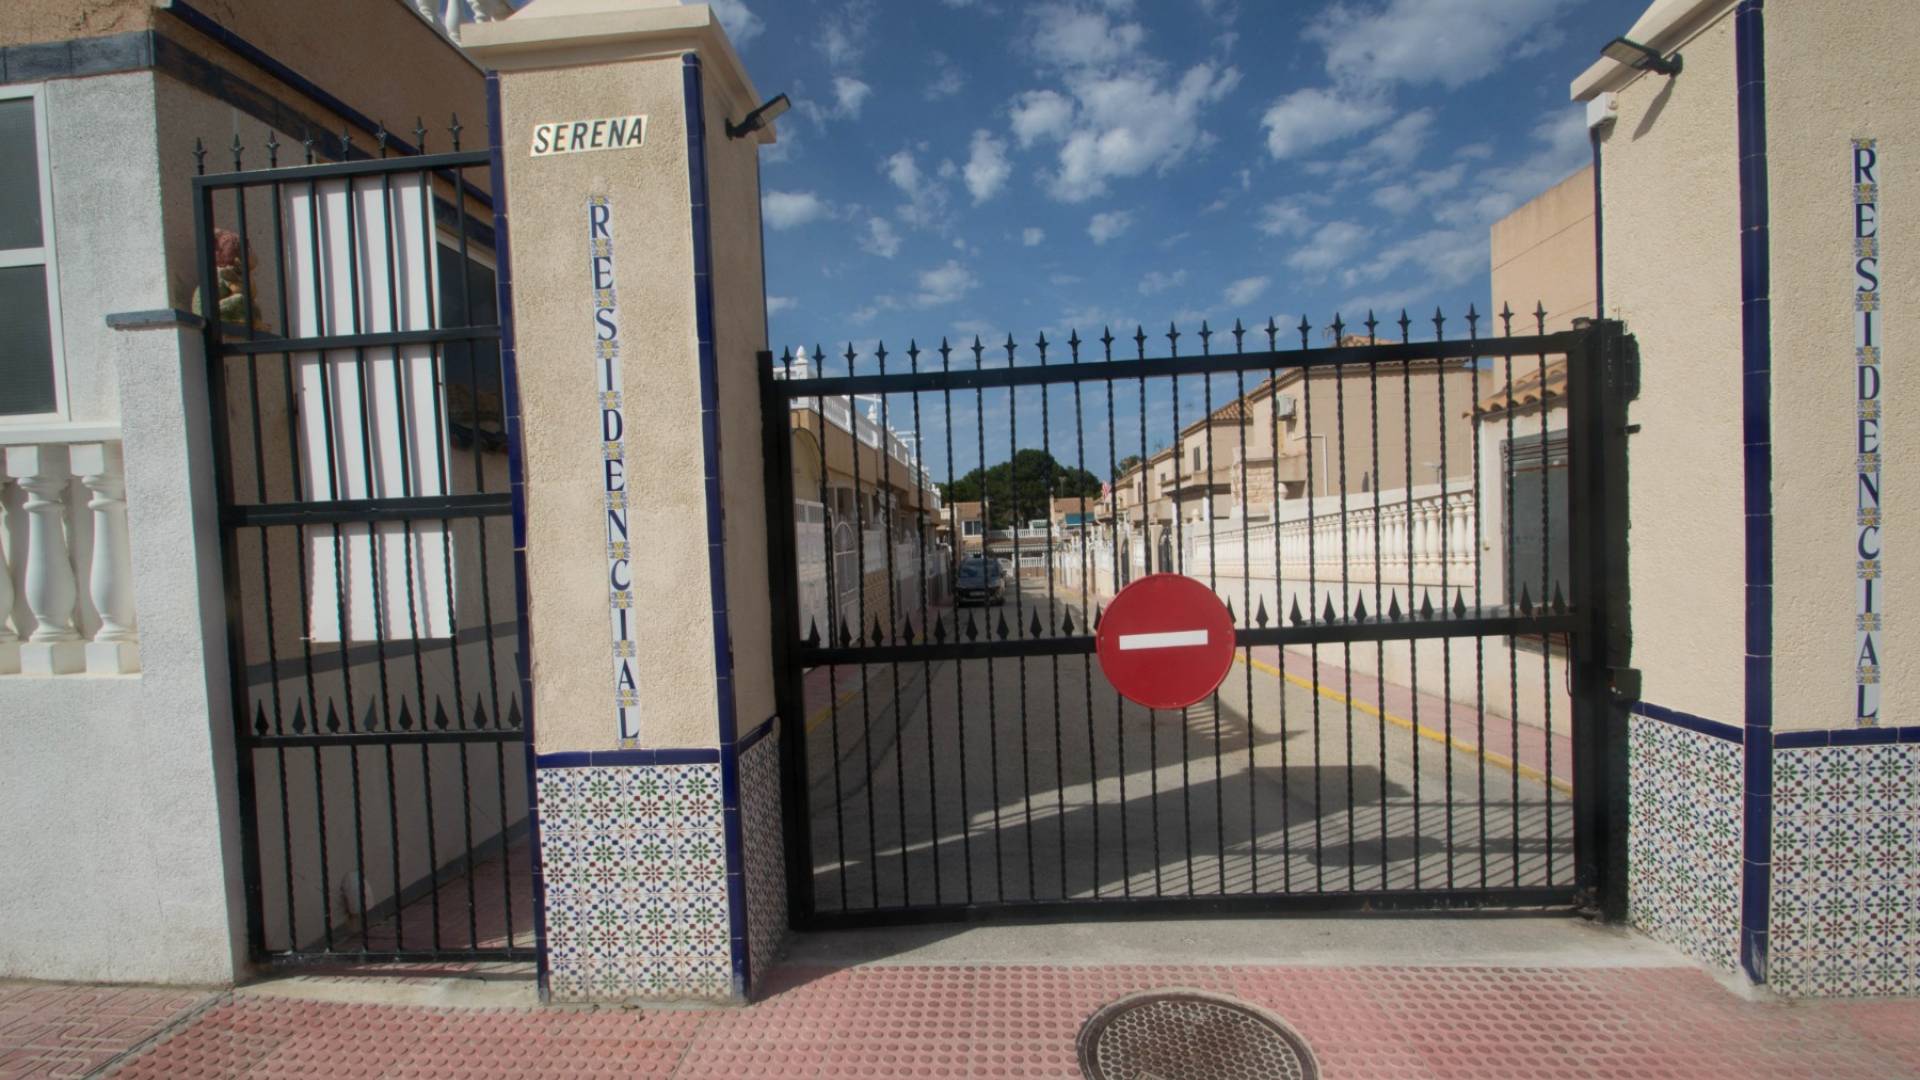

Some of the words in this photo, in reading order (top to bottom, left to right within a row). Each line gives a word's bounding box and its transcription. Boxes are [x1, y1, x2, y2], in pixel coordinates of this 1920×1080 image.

[534, 117, 642, 154] SERENA
[589, 204, 640, 739] RESIDENCIAL
[1853, 148, 1881, 718] RESIDENCIAL
